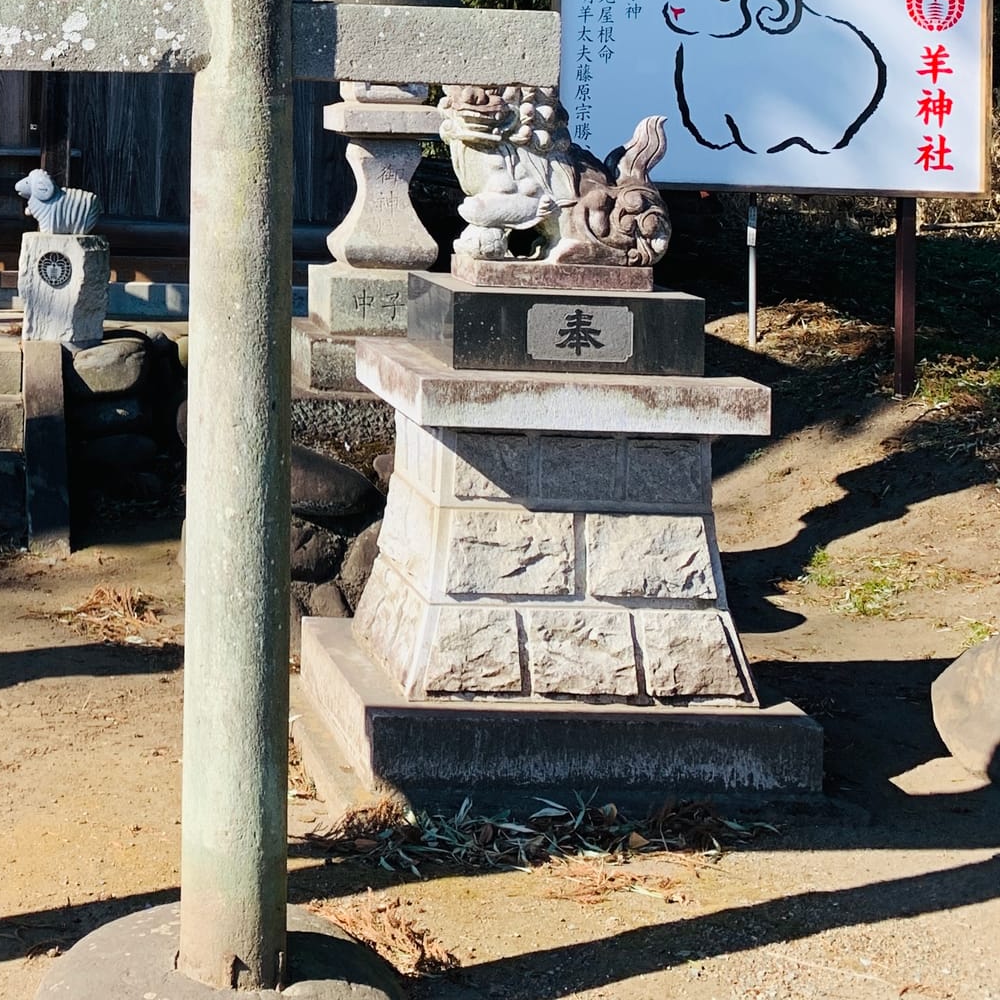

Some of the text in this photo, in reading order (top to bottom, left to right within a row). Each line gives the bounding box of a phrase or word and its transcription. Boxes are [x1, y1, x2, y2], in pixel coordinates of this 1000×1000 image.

[915, 44, 955, 172] 羊神社
[554, 308, 605, 356] 奉
